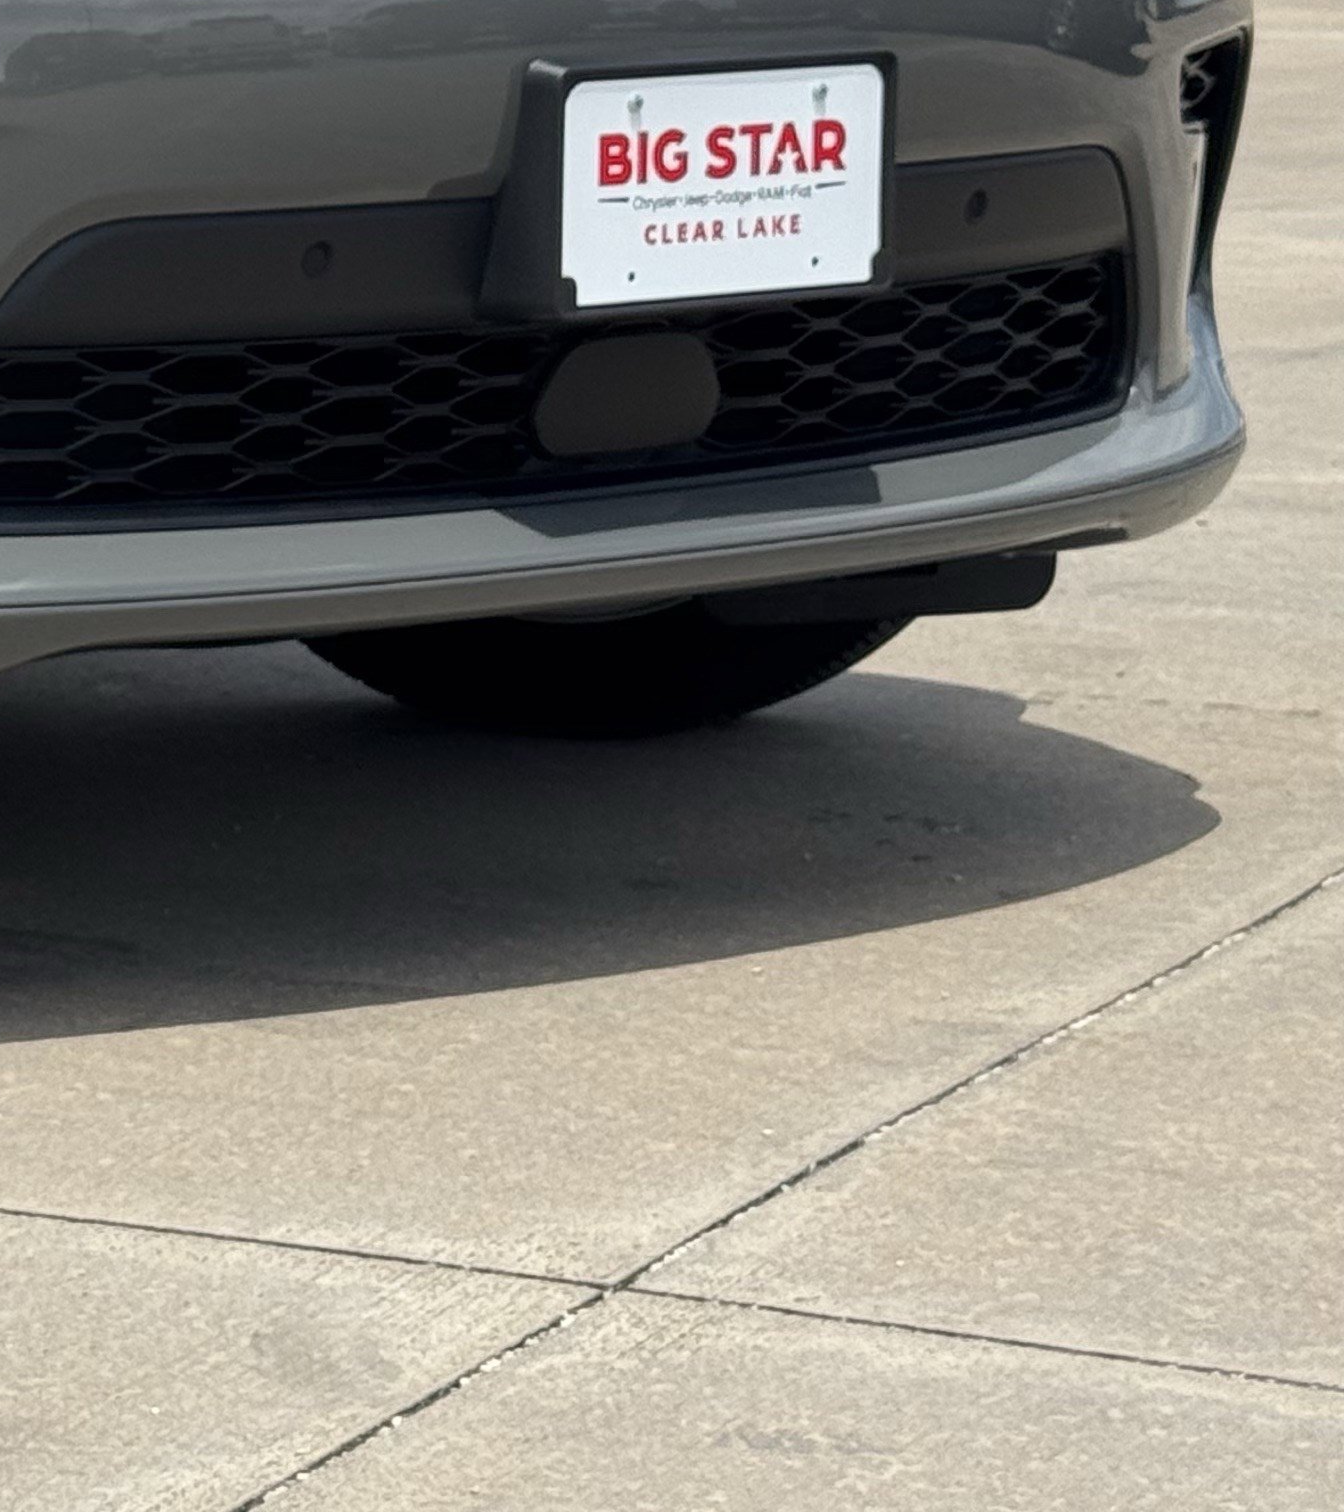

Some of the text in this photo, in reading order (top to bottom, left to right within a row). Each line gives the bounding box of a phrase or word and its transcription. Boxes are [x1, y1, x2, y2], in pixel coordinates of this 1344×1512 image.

[597, 119, 848, 187] BIG STAR
[643, 213, 803, 246] CLEAR LAKE
